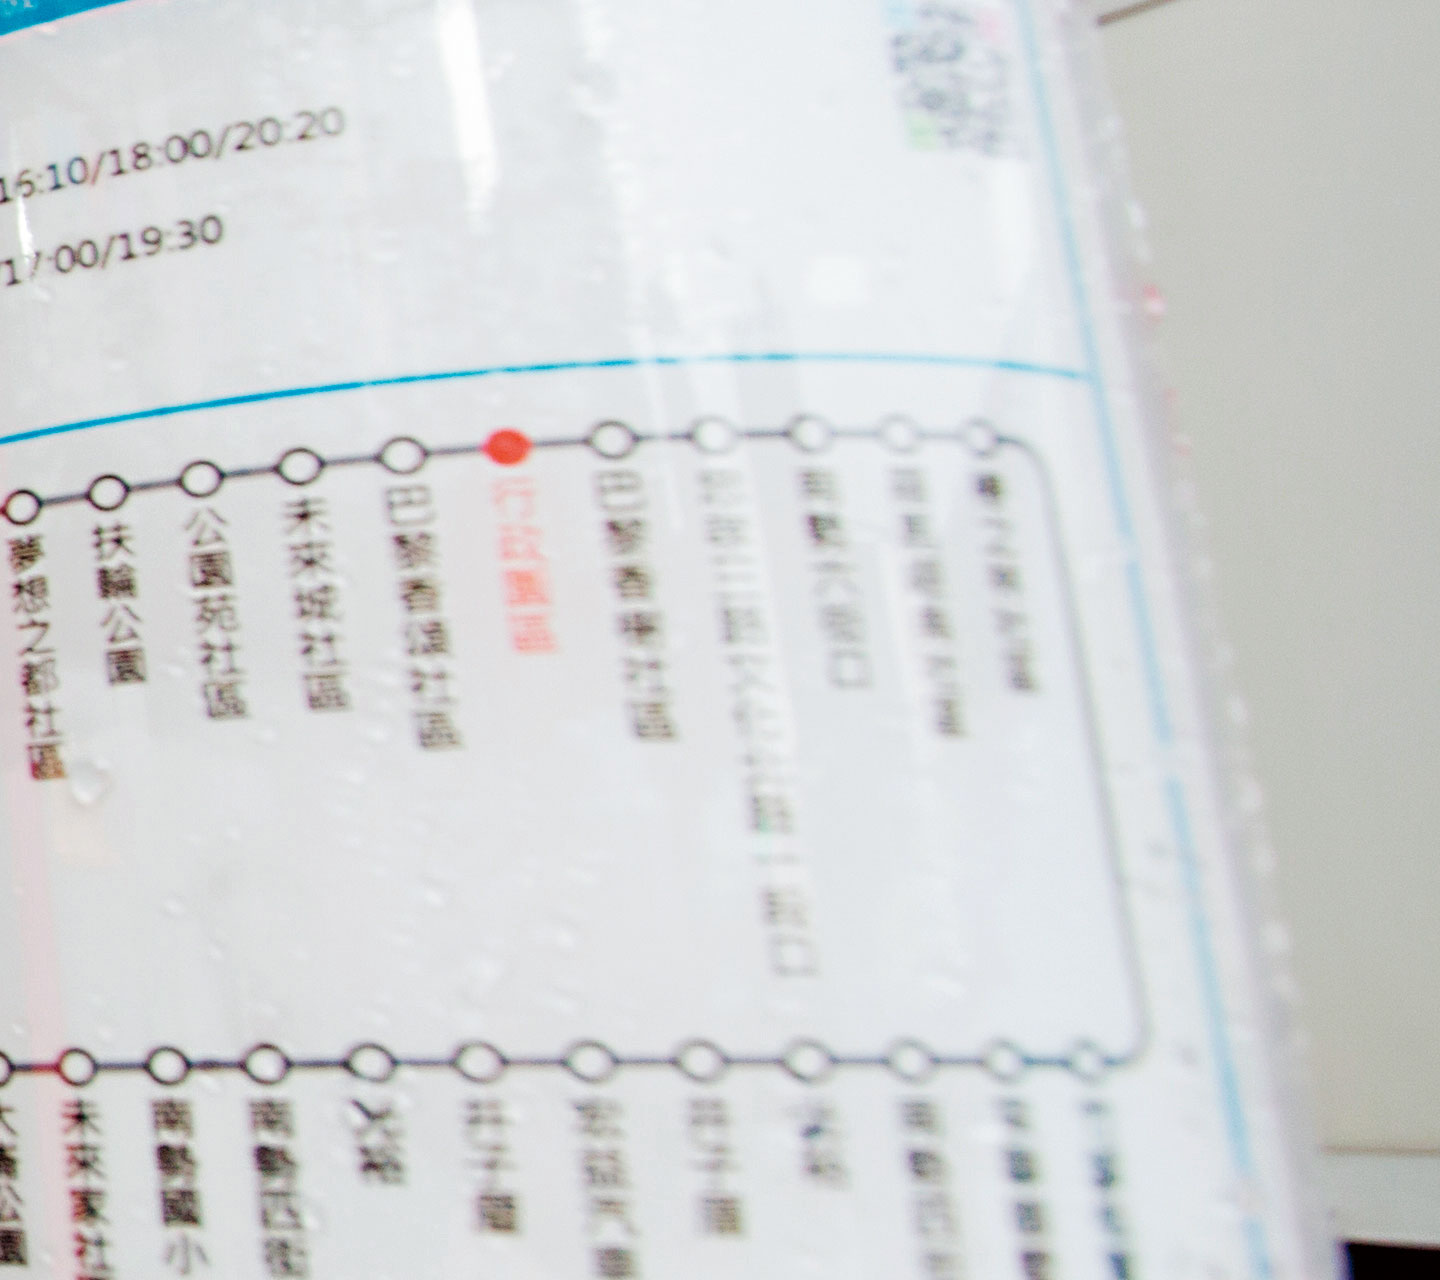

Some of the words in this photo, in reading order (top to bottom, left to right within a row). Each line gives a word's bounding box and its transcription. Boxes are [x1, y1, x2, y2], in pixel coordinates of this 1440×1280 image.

[89, 521, 148, 688] 扶輪公園
[148, 1096, 212, 1278] 南勢國小
